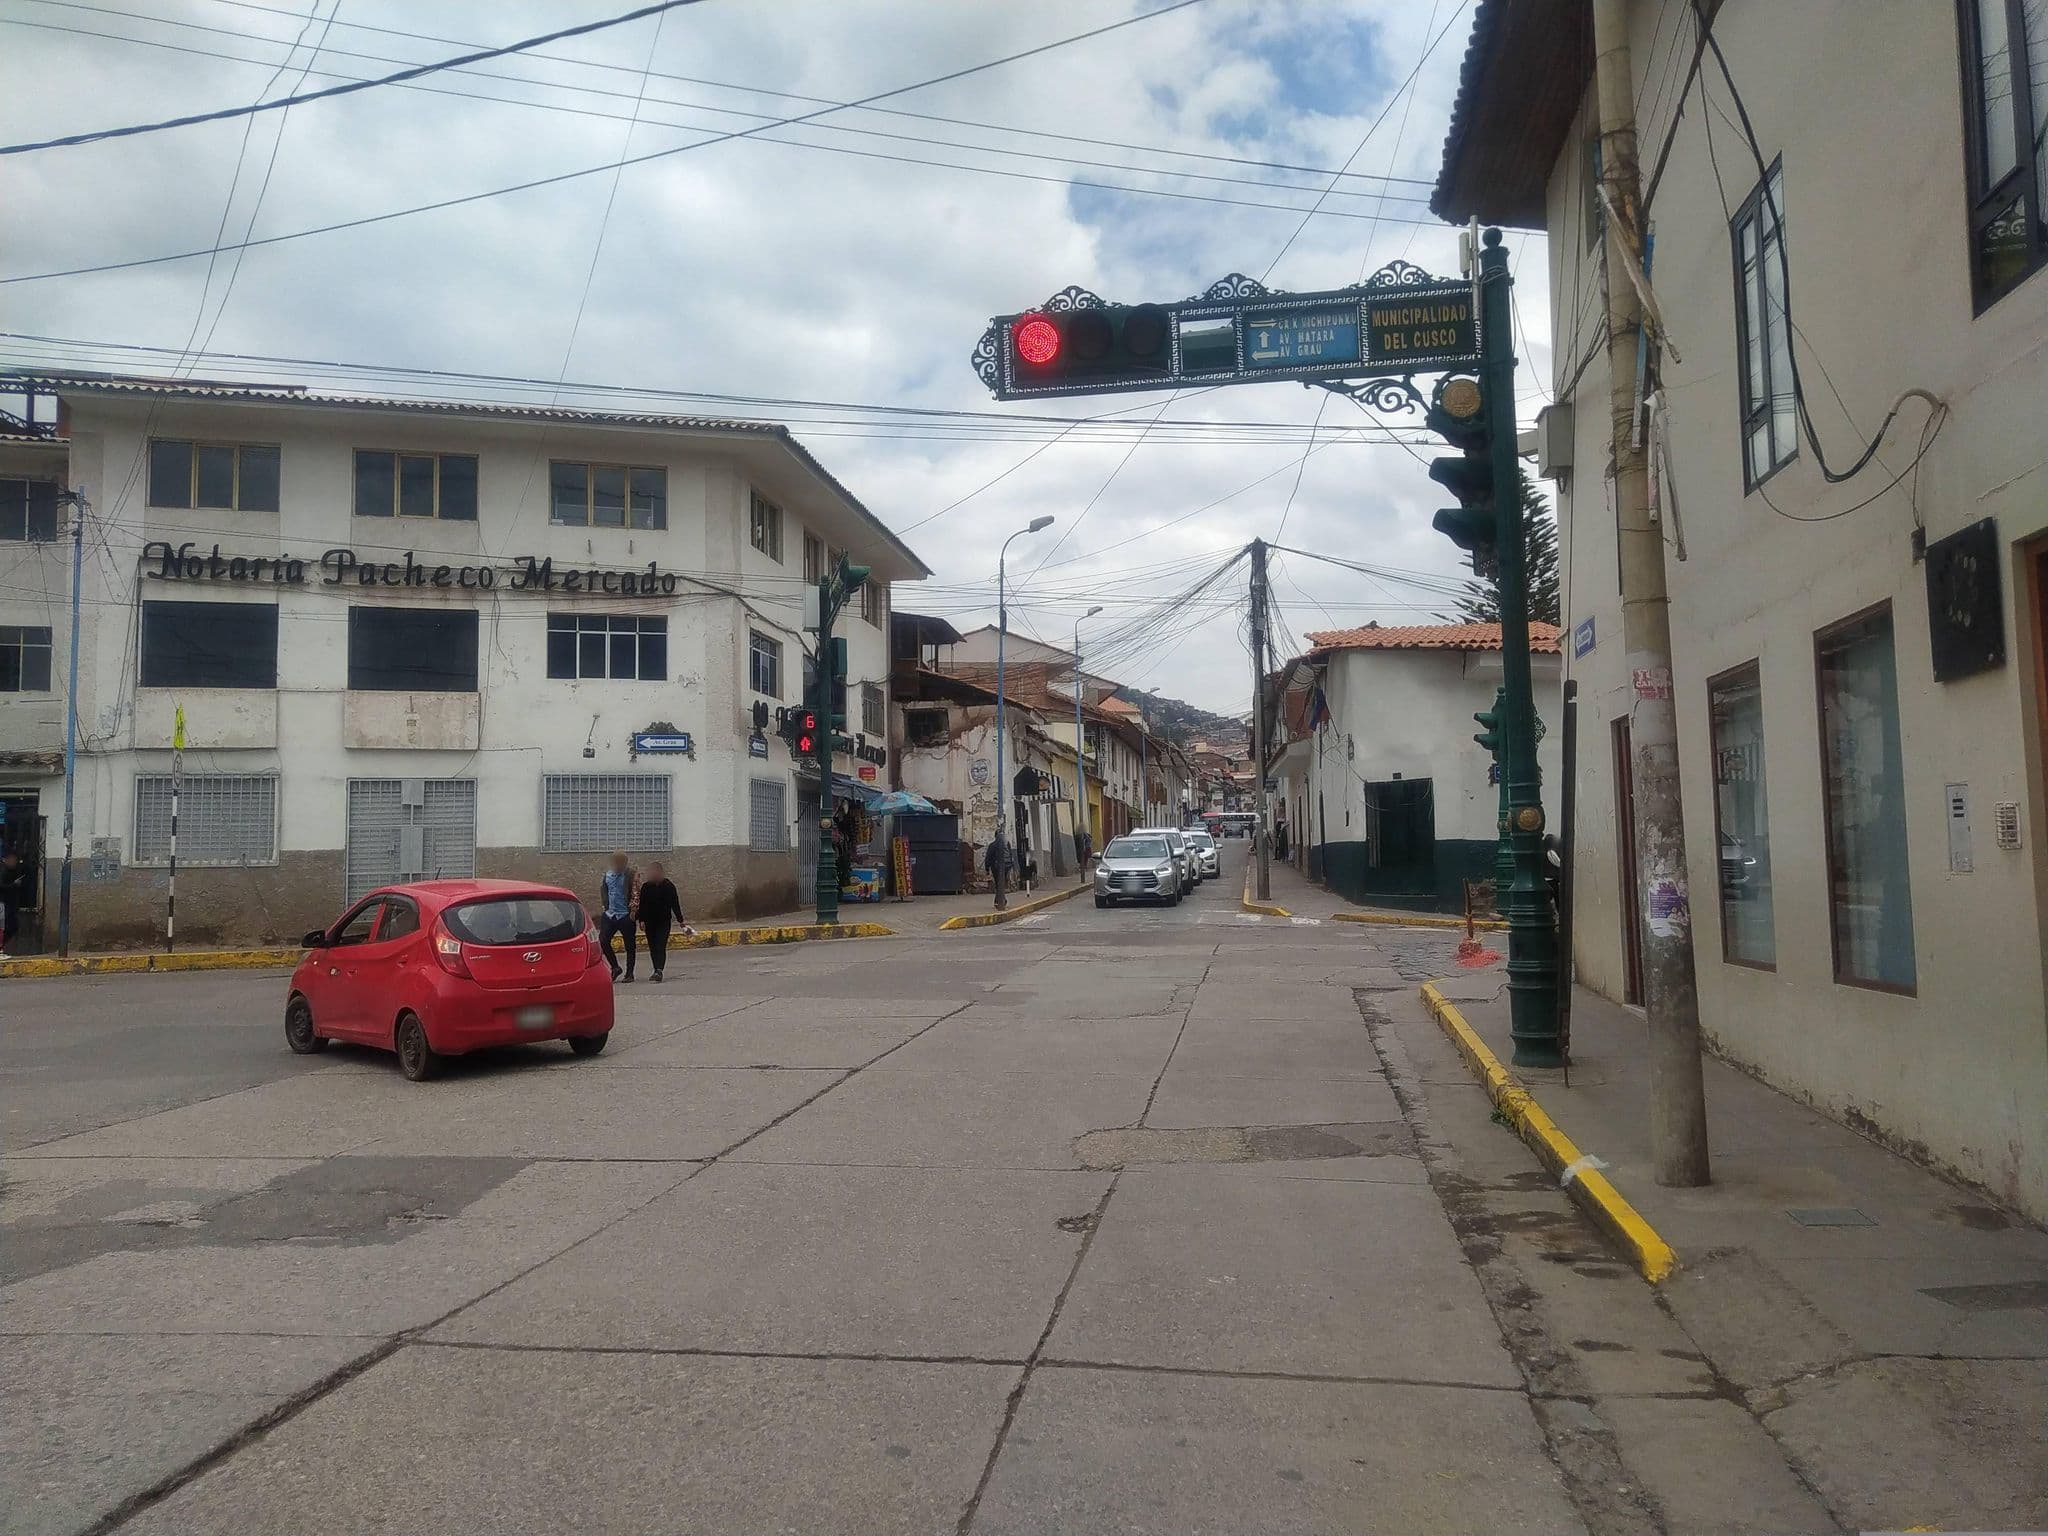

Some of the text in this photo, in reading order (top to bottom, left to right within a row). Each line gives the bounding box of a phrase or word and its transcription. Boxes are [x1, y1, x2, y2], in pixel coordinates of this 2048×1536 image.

[1371, 304, 1467, 327] MUNICIPALIDAD
[1298, 330, 1335, 344] MATARA
[1384, 328, 1457, 350] DEL CUSCO
[1297, 345, 1322, 357] GRAU
[143, 542, 676, 596] Notaria Pacheco Mercado
[806, 715, 815, 728] 6
